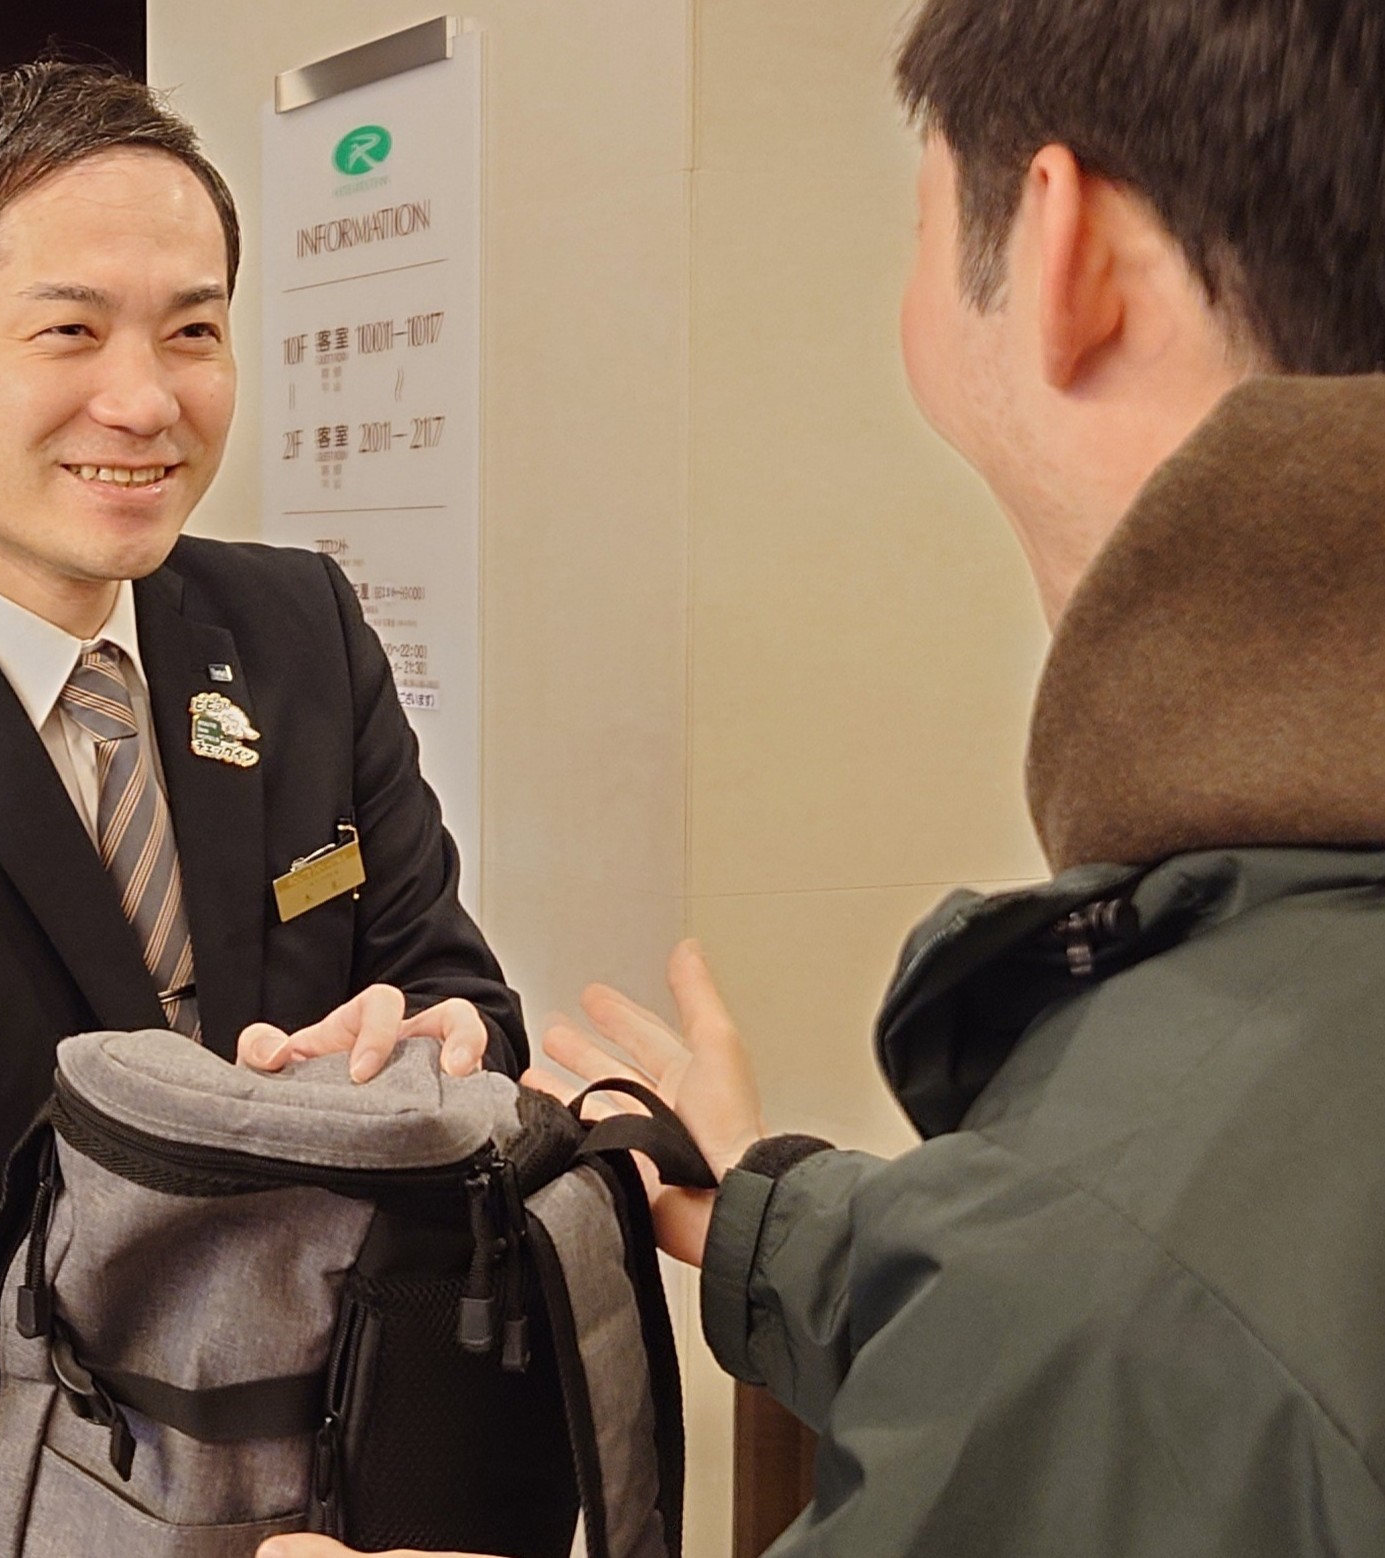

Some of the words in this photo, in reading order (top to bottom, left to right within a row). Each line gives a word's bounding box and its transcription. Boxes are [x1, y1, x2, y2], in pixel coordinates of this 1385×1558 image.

[297, 199, 430, 258] INFORMATION
[281, 333, 308, 365] 10F
[315, 327, 349, 352] 客室
[282, 430, 303, 460] 2F
[315, 425, 349, 449] 客室
